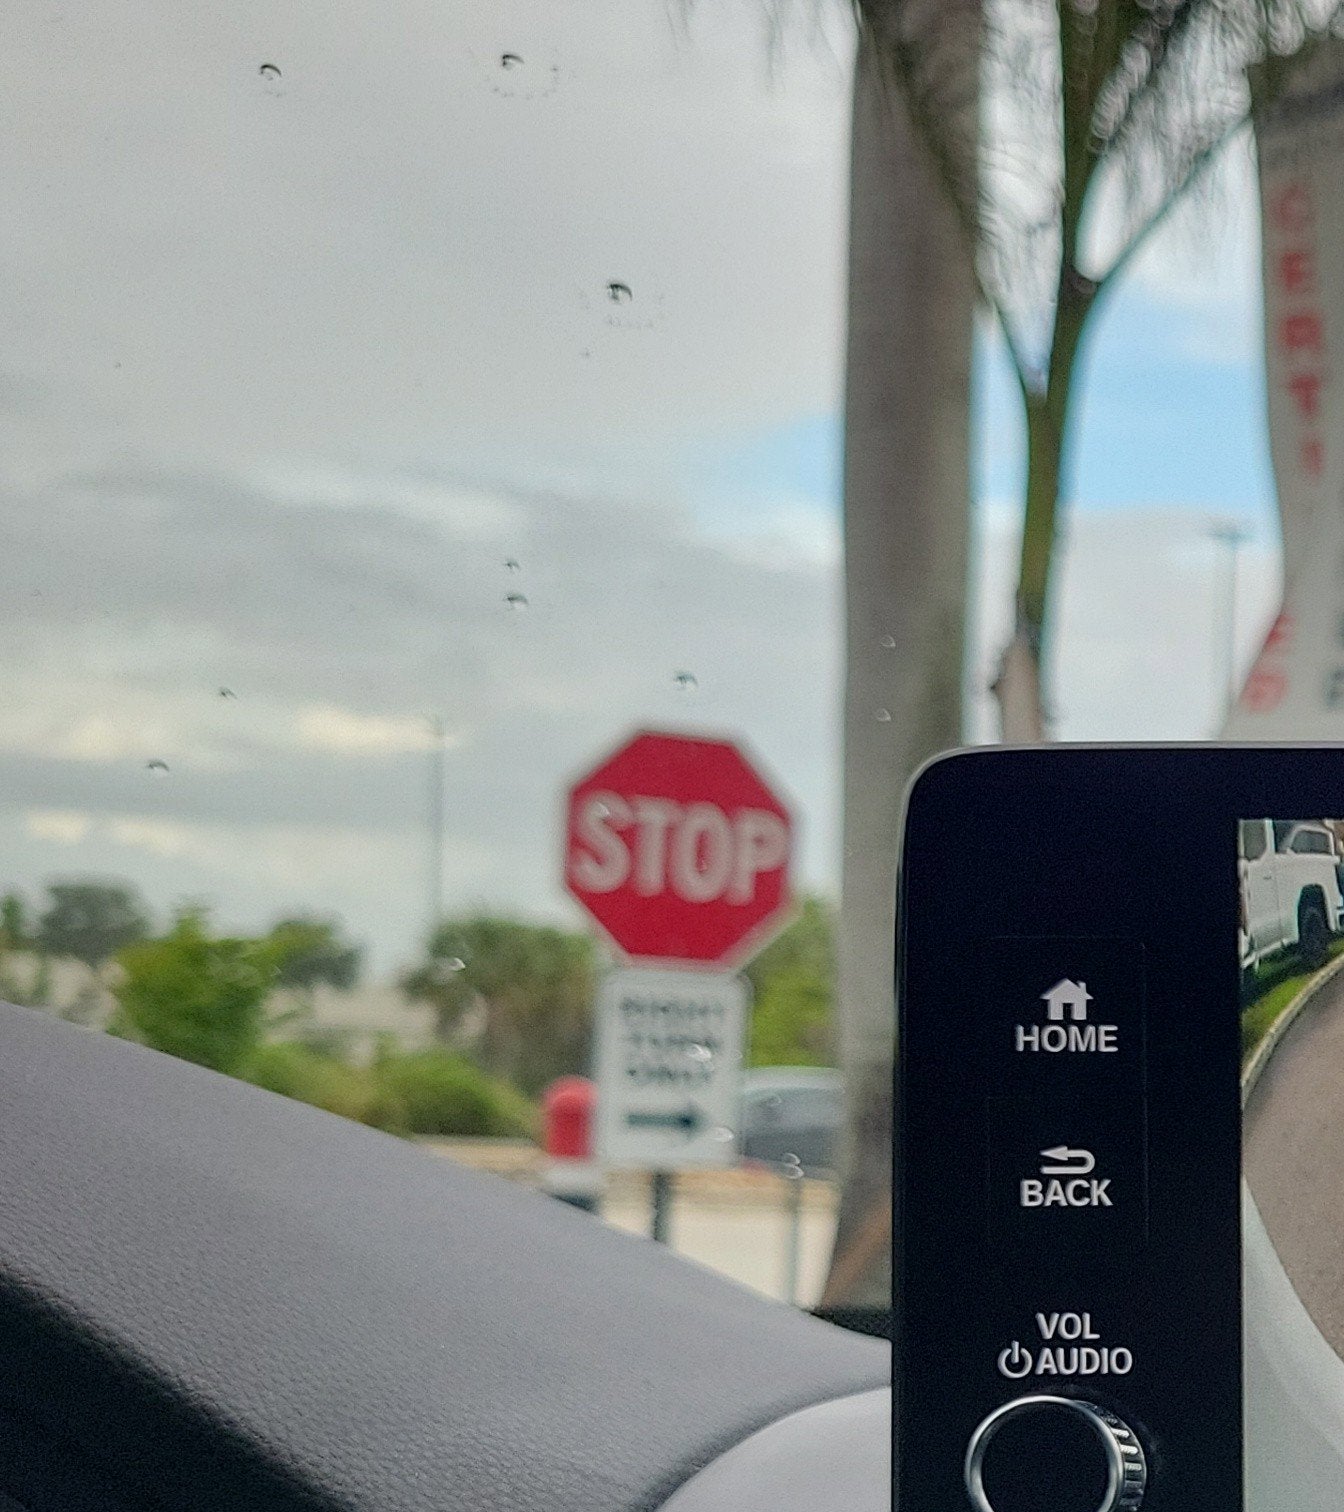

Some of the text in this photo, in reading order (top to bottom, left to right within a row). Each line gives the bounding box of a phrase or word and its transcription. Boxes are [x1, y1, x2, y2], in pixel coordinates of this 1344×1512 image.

[571, 793, 790, 906] STOP
[1016, 1025, 1118, 1053] HOME
[1020, 1179, 1113, 1207] BACK
[1036, 1312, 1100, 1340] VOL
[1035, 1347, 1133, 1375] AUDIO
